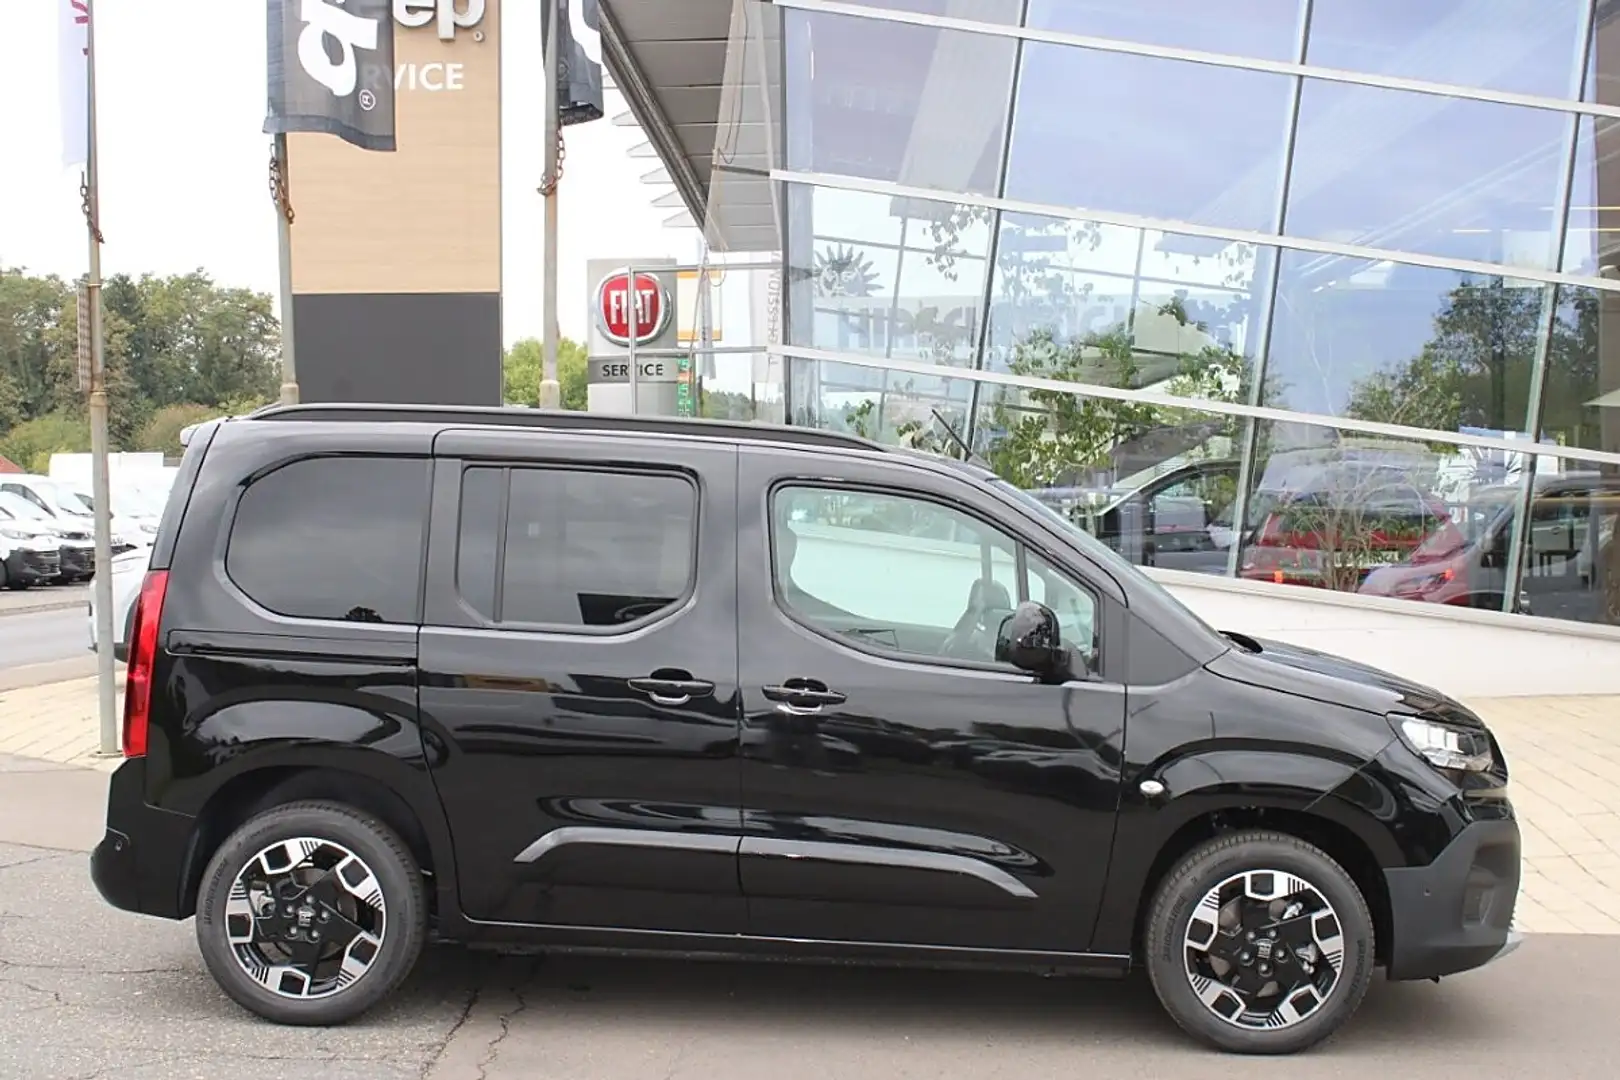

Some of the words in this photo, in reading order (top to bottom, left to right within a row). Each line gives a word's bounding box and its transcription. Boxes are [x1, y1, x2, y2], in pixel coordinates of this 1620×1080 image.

[393, 0, 485, 40] ep
[609, 289, 655, 325] FIAT
[602, 363, 664, 377] SERICE
